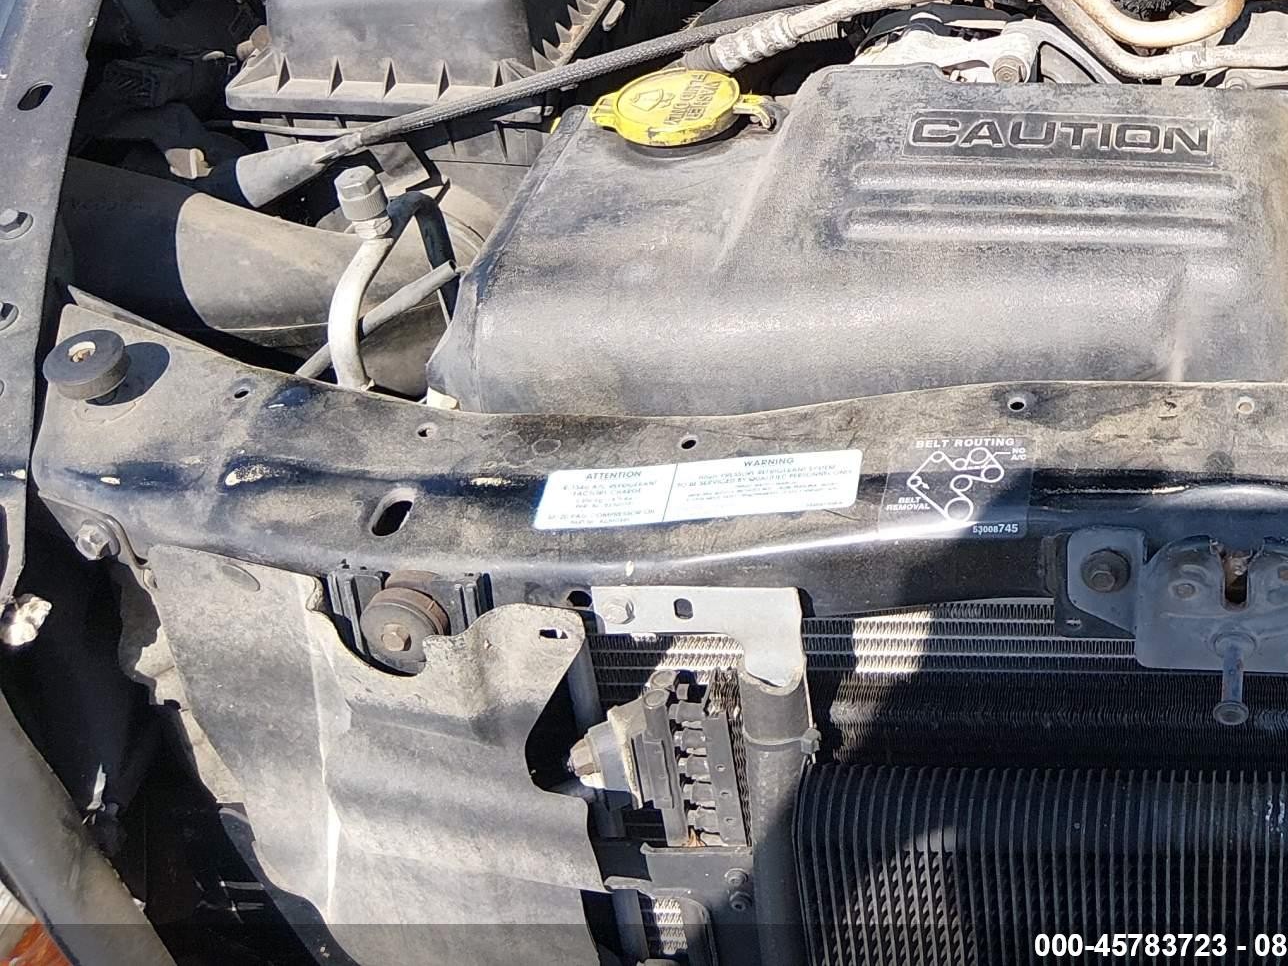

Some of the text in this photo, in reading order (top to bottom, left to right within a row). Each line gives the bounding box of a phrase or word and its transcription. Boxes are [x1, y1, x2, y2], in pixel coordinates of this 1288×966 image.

[910, 118, 1210, 154] CAUTION
[916, 437, 1015, 449] BELT ROUTING
[744, 457, 795, 467] WARNING
[585, 470, 642, 480] ATTENTION
[898, 496, 921, 504] BELT
[885, 502, 930, 510] REMOVAL
